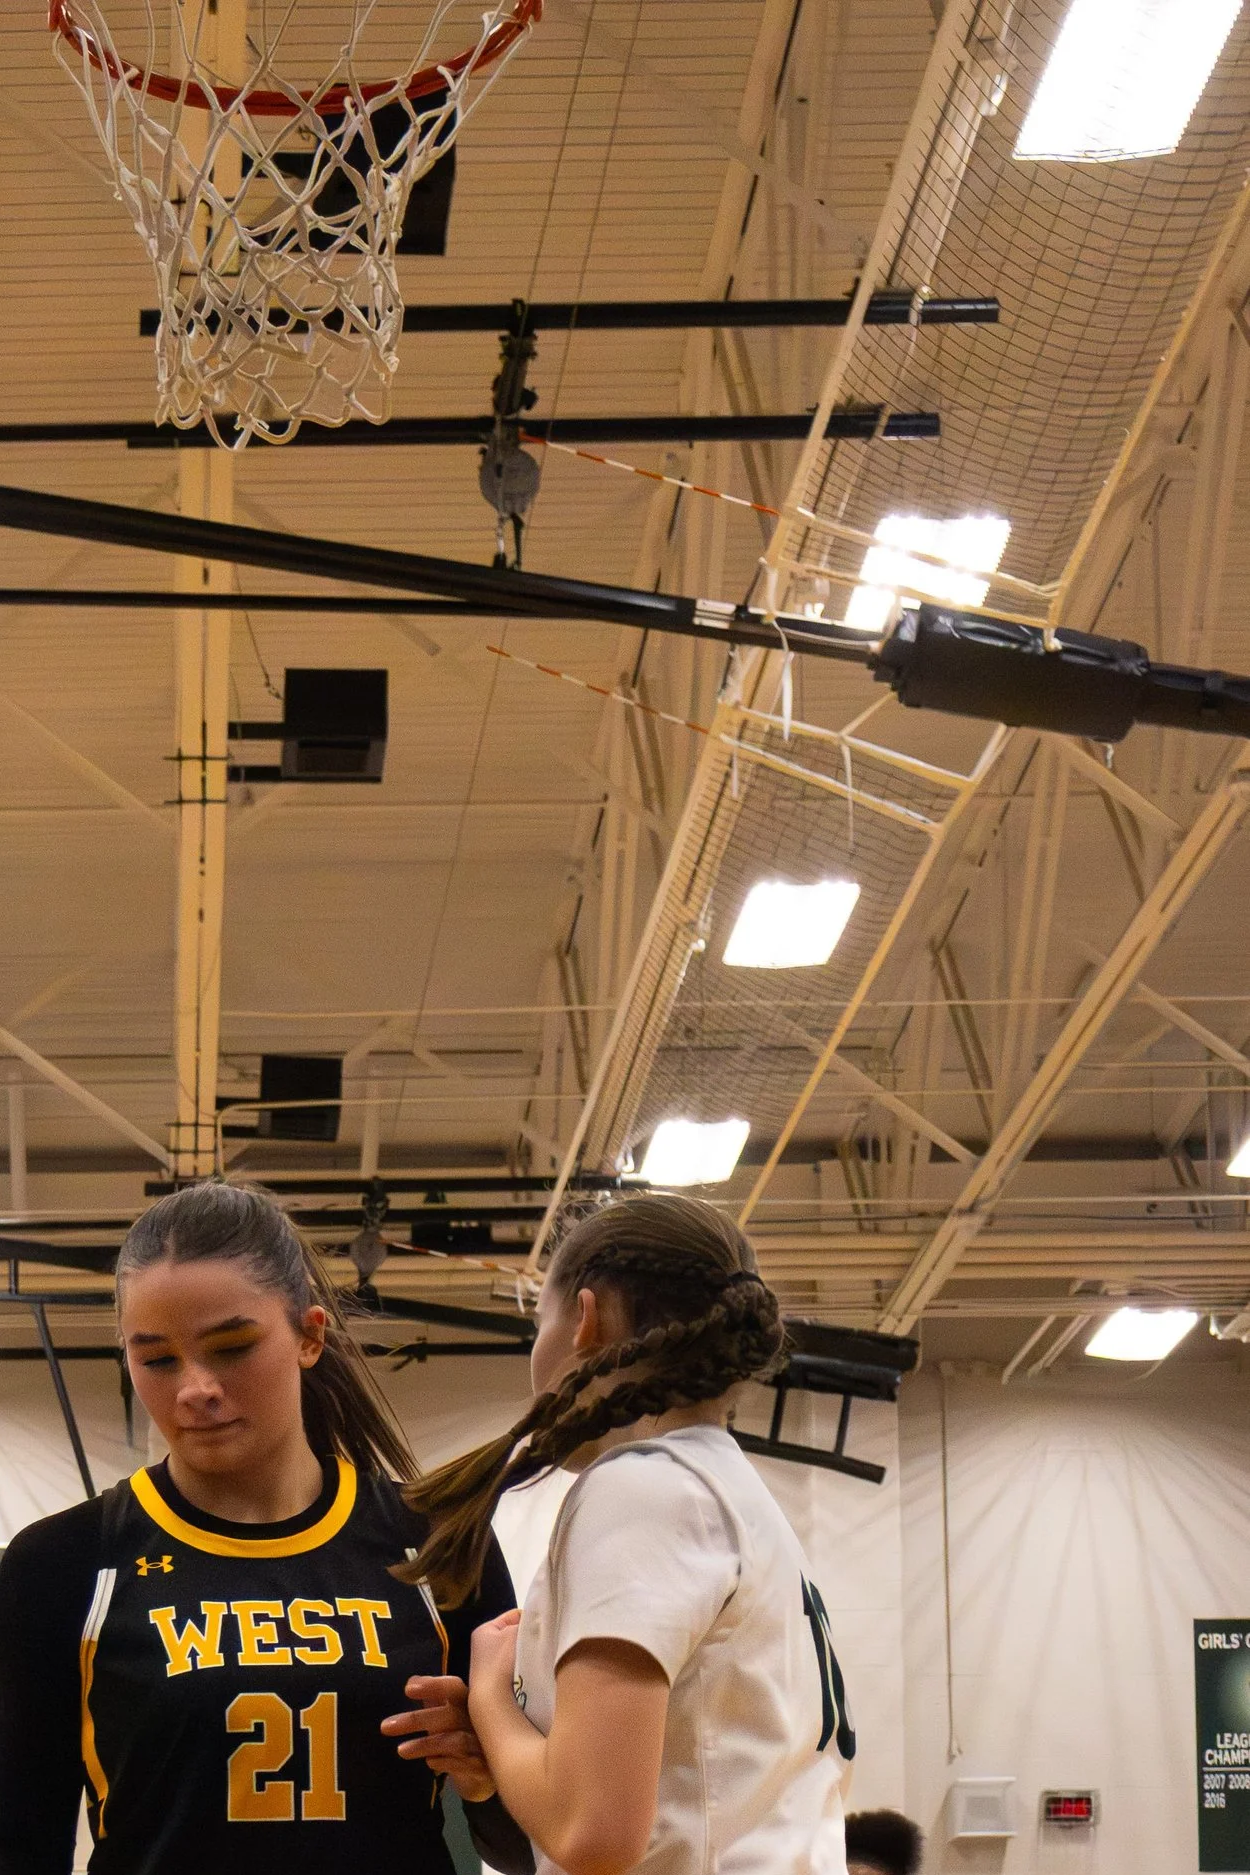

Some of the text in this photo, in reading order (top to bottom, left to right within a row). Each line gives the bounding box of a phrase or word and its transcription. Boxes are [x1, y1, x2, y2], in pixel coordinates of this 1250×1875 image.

[147, 1597, 393, 1678] WEST
[1197, 1632, 1243, 1649] GIRLS'
[225, 1691, 347, 1822] 21
